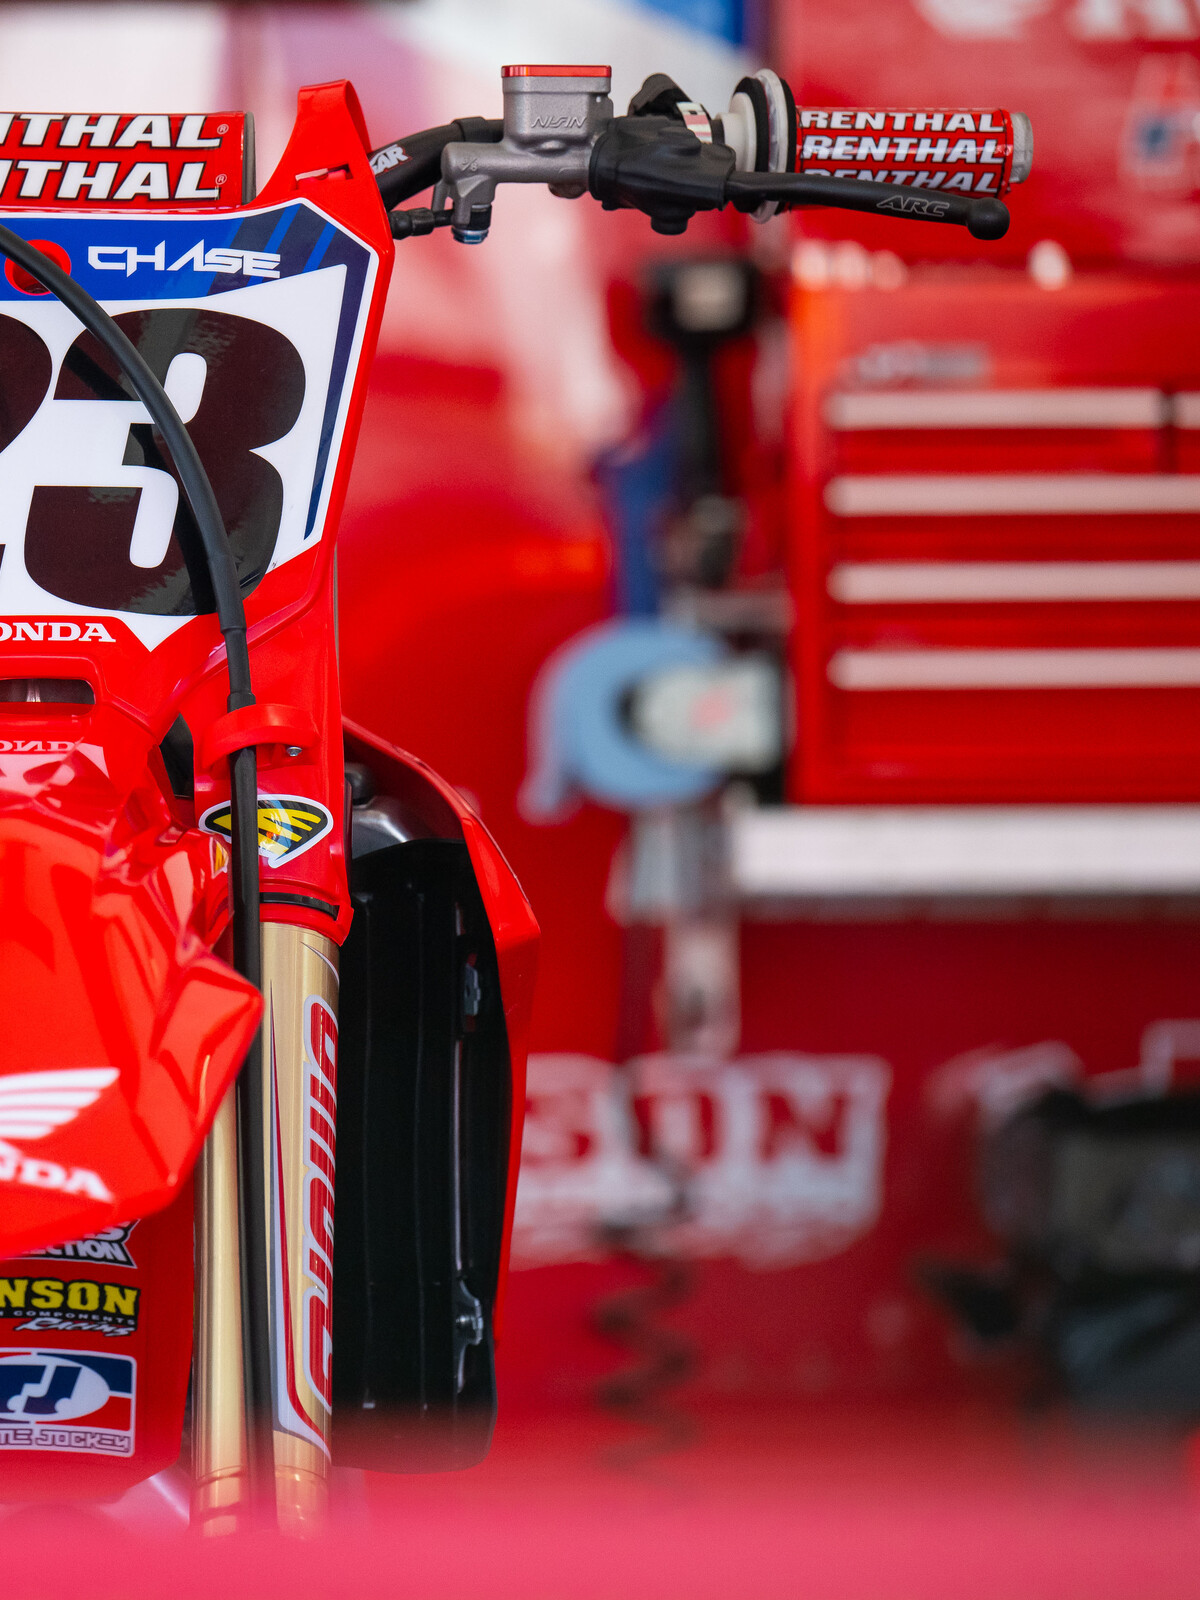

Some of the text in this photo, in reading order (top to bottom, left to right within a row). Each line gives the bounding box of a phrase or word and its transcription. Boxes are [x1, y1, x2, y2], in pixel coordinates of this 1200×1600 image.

[800, 111, 1005, 133] RENTHAL
[801, 135, 1005, 164] RENTHAL
[876, 195, 950, 217] ARC
[87, 238, 281, 279] CHASE
[13, 1310, 136, 1326] COMPONENTS
[35, 1428, 131, 1454] JOCKEY
